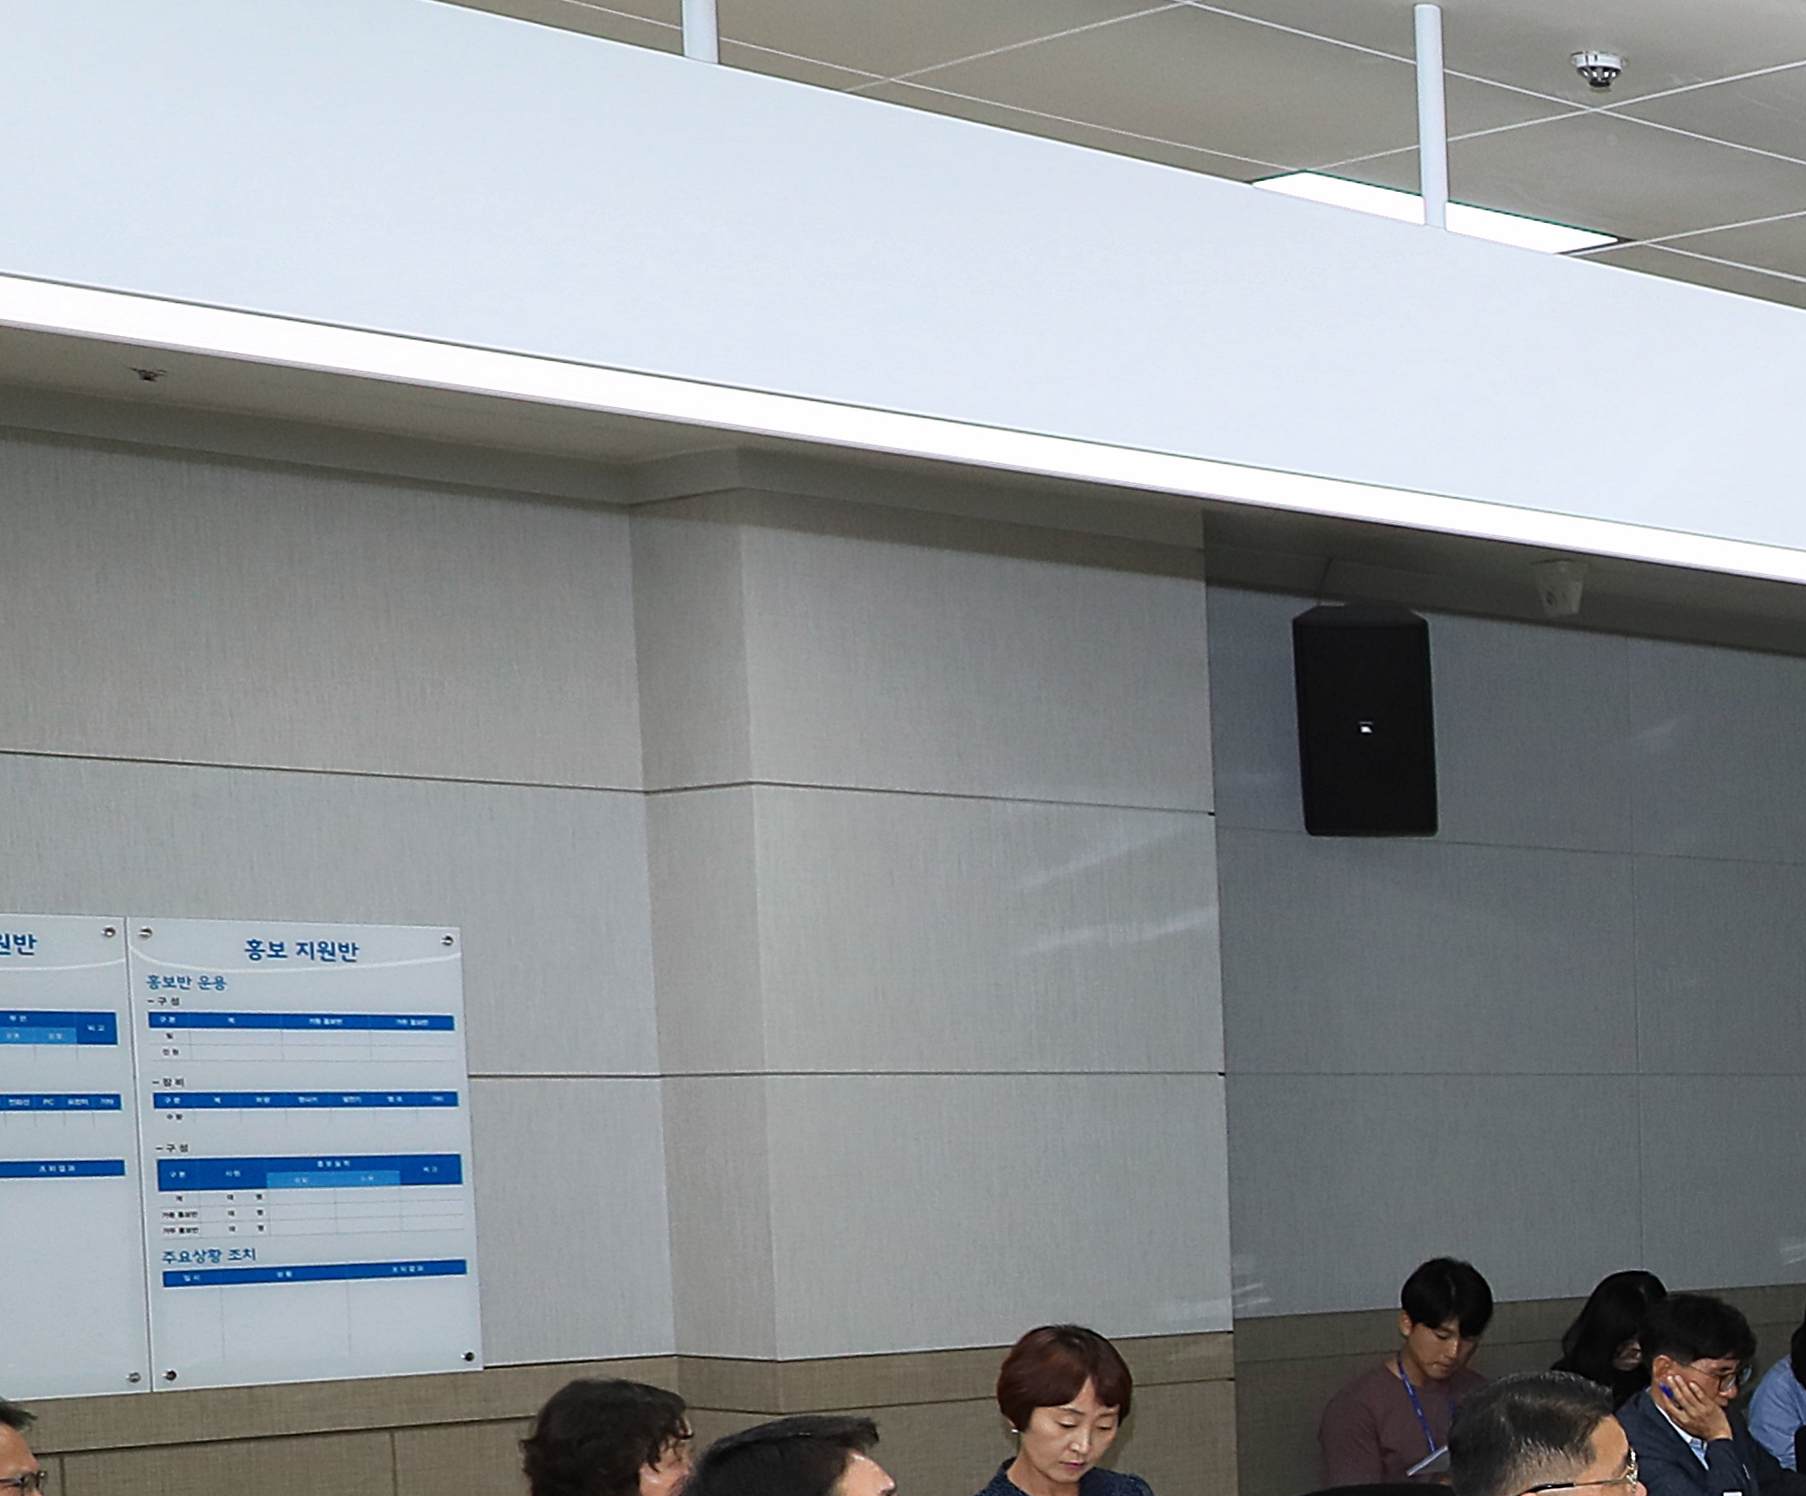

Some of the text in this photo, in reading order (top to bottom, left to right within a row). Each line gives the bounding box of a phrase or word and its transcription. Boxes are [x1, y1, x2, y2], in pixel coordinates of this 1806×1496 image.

[244, 938, 360, 963] 홍보 지원반
[146, 974, 227, 991] 홍보반 운용
[162, 1247, 257, 1264] 주요상황 조치
